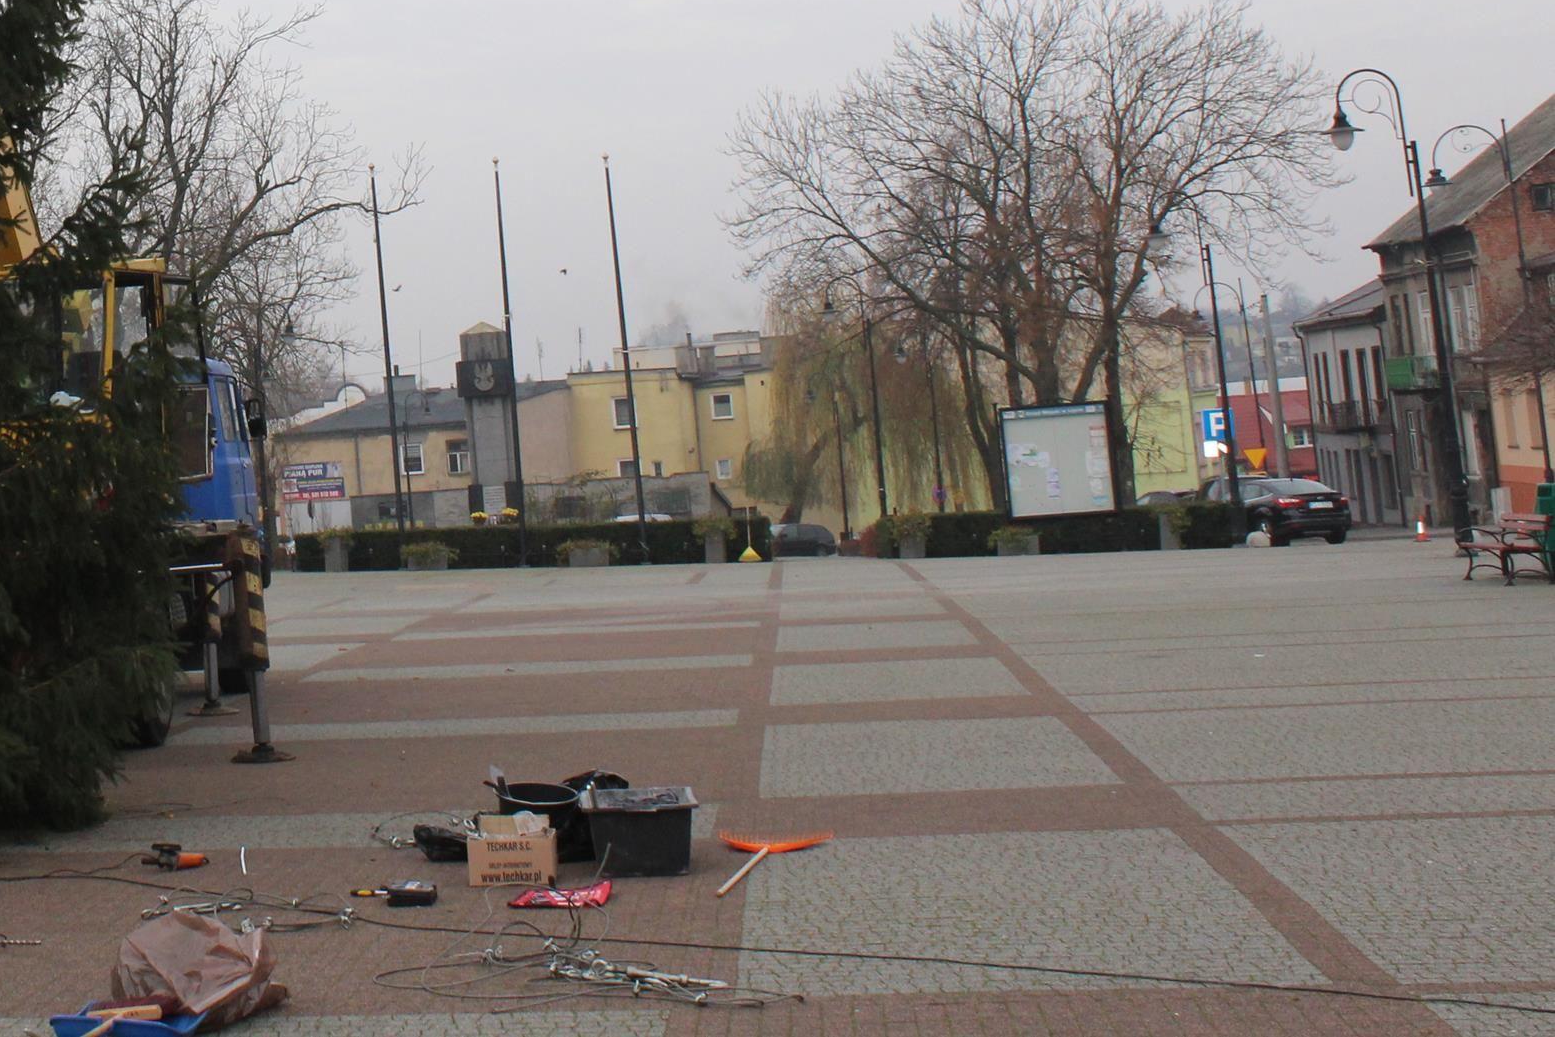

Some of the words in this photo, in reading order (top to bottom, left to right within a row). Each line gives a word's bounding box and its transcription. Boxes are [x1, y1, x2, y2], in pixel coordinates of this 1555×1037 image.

[1210, 413, 1225, 436] P
[486, 841, 517, 852] TECHKAR
[480, 870, 542, 883] www.techkar.pl
